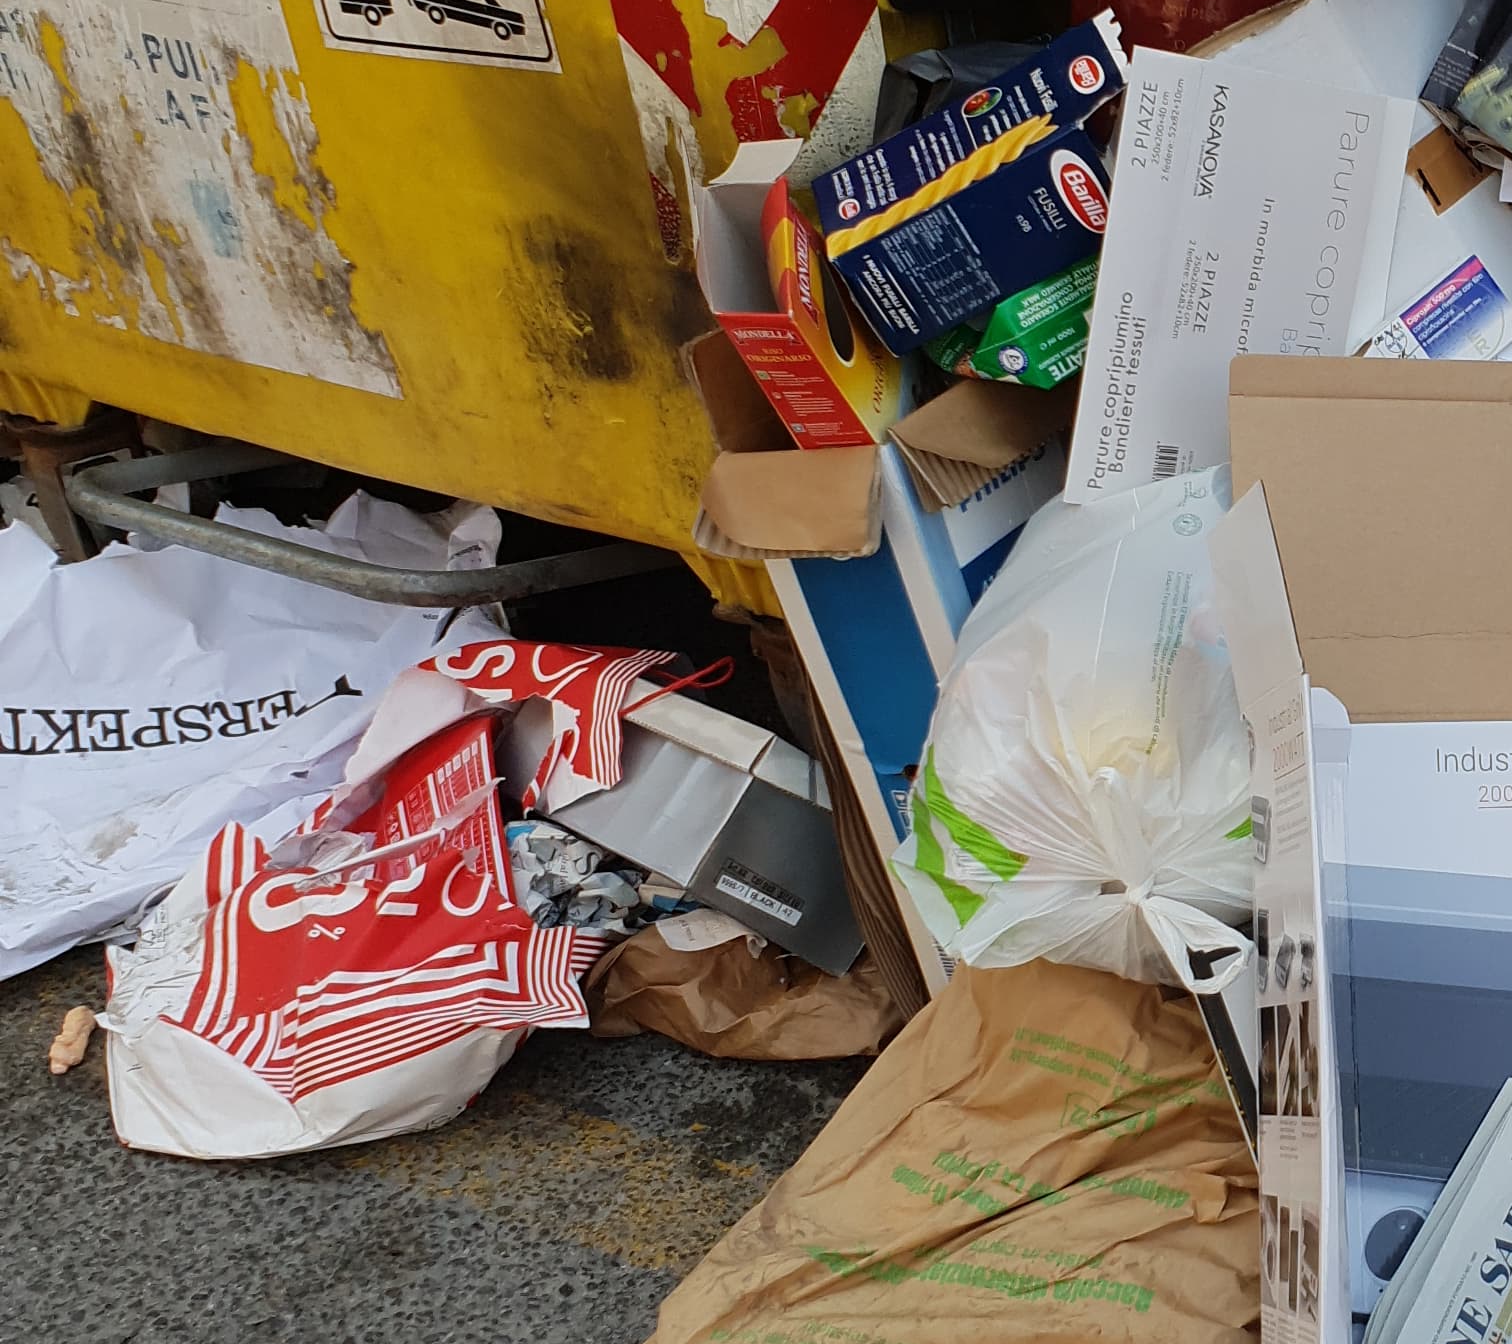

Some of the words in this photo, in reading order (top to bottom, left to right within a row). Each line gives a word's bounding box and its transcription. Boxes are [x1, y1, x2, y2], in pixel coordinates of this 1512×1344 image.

[1135, 80, 1158, 151] PIAZZE
[1160, 91, 1170, 102] cm
[1132, 157, 1145, 169] 2
[1199, 85, 1230, 198] KASANOVA
[1328, 109, 1370, 232] Parure
[1034, 187, 1067, 230] FUSILLI
[1062, 169, 1105, 226] Barilla
[1264, 198, 1275, 214] In
[1207, 252, 1219, 262] 2
[1248, 220, 1272, 291] morbida
[1193, 269, 1217, 334] PIAZZE
[1087, 426, 1112, 489] Parure
[1103, 291, 1134, 419] copripiumino
[1109, 383, 1135, 474] Bandiera
[1126, 316, 1148, 376] tessuti
